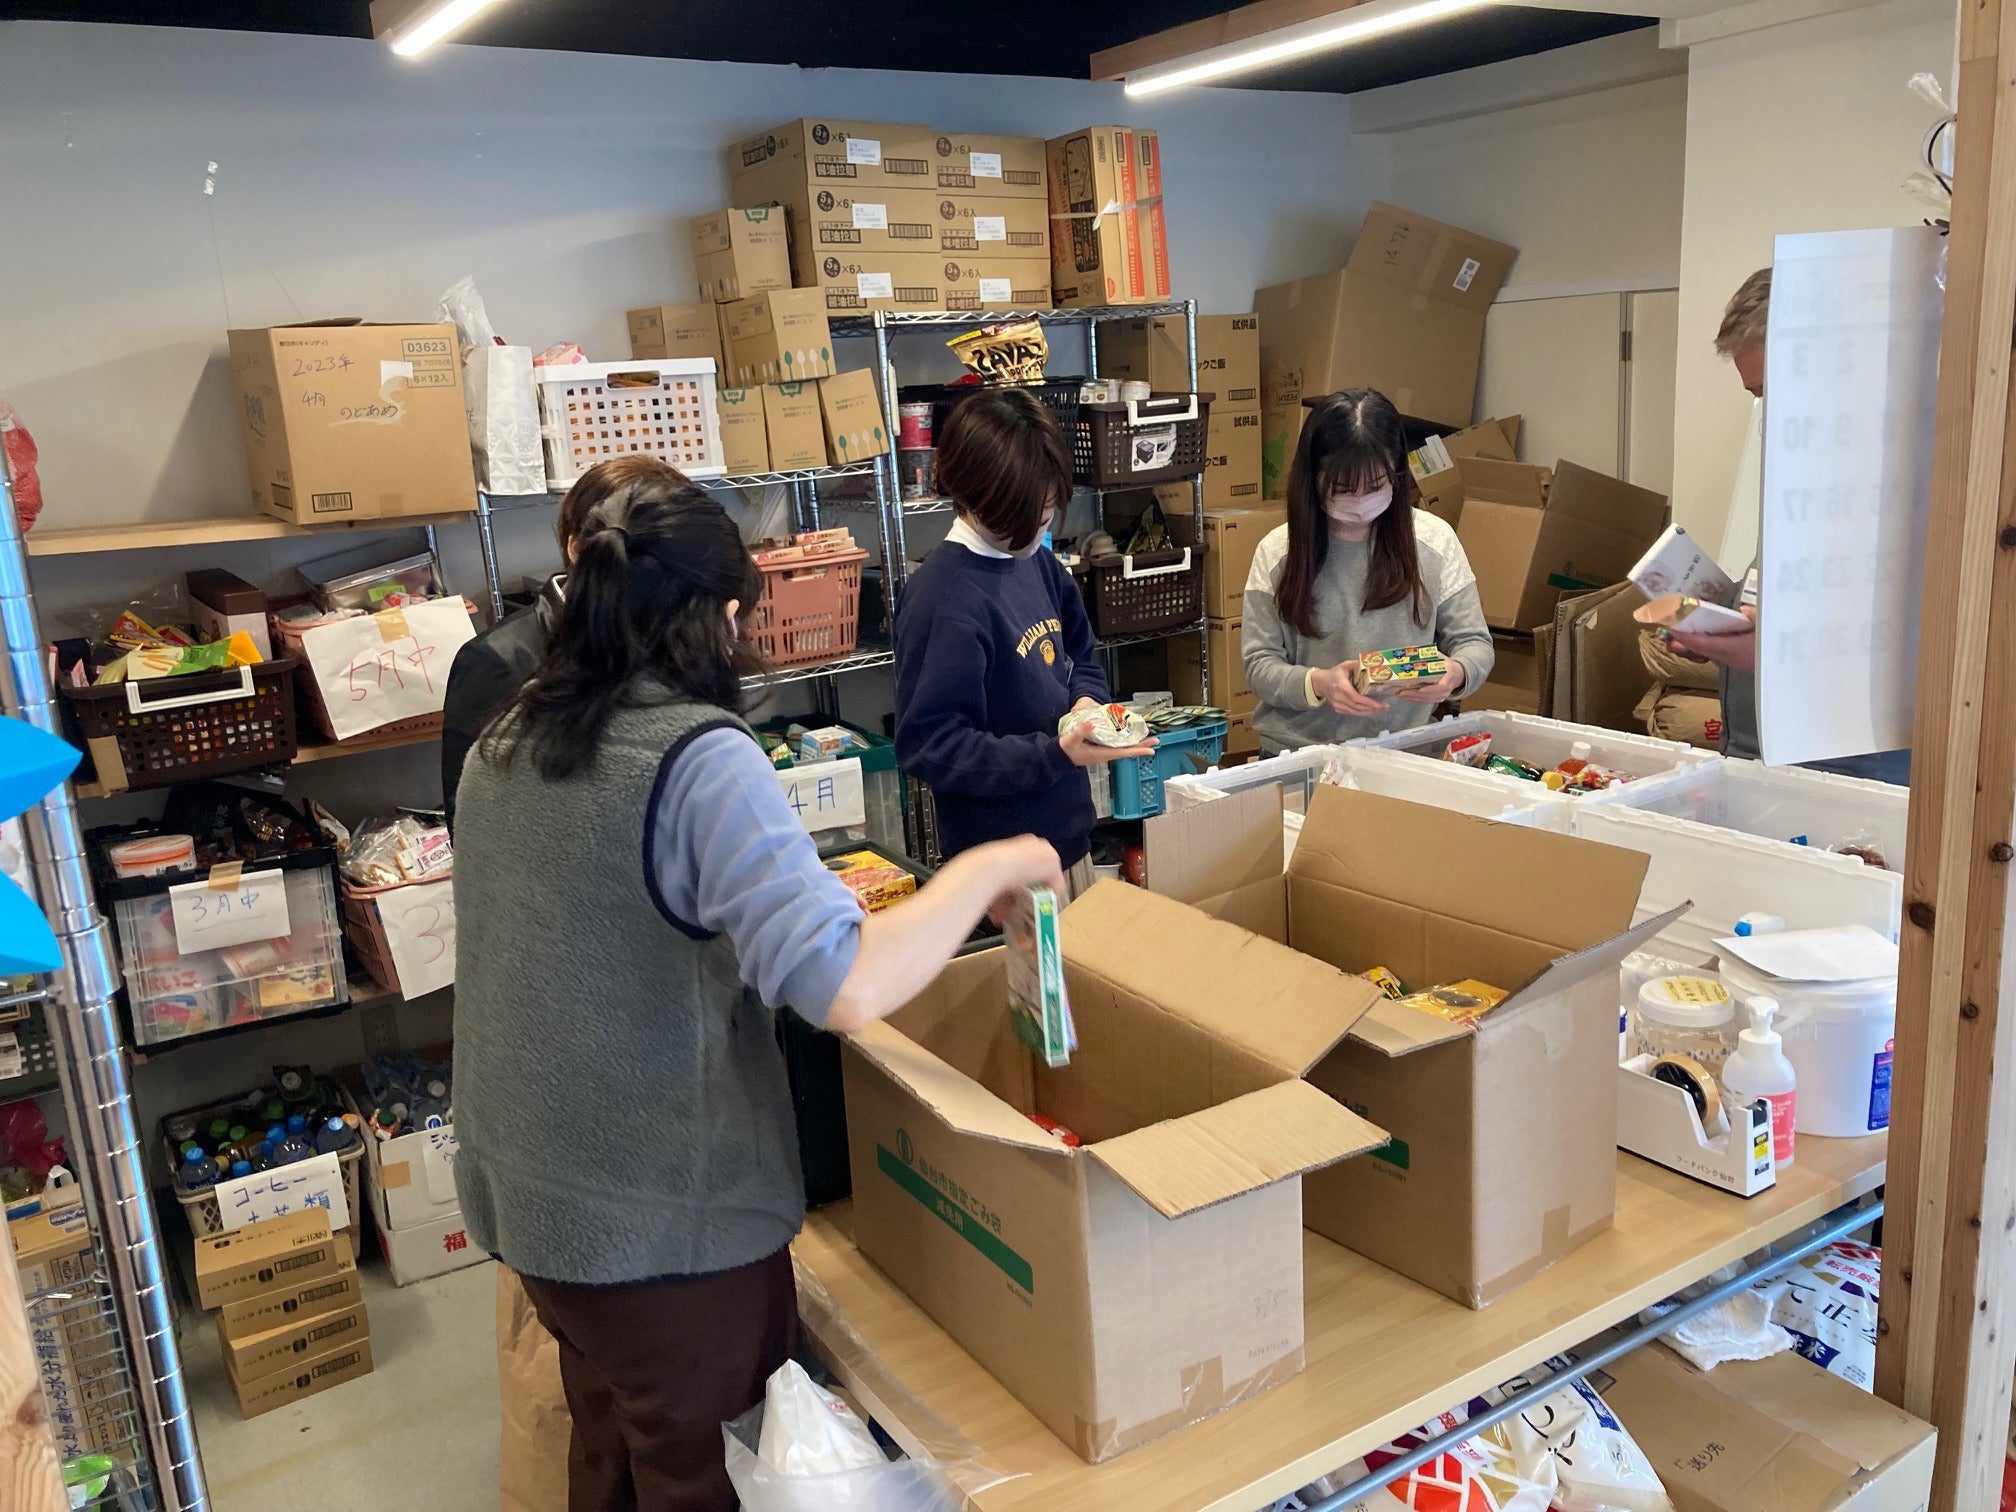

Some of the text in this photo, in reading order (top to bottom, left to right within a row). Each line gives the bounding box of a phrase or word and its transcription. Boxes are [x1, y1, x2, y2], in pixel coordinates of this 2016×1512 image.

[1232, 319, 1257, 330] 試供品
[407, 341, 447, 352] 03623
[971, 337, 1043, 373] SAVAS
[293, 354, 354, 376] 2023年
[413, 374, 448, 384] 6×12入
[1234, 416, 1258, 427] 試供品
[1016, 620, 1048, 659] WILLIAM
[349, 636, 435, 701] 5月中
[788, 777, 835, 815] 4月
[190, 887, 260, 923] 3月中
[403, 905, 446, 965] 3
[1676, 1155, 1735, 1184] フードバンク仙台
[233, 1176, 307, 1208] コーヒー
[442, 1230, 467, 1253] 福
